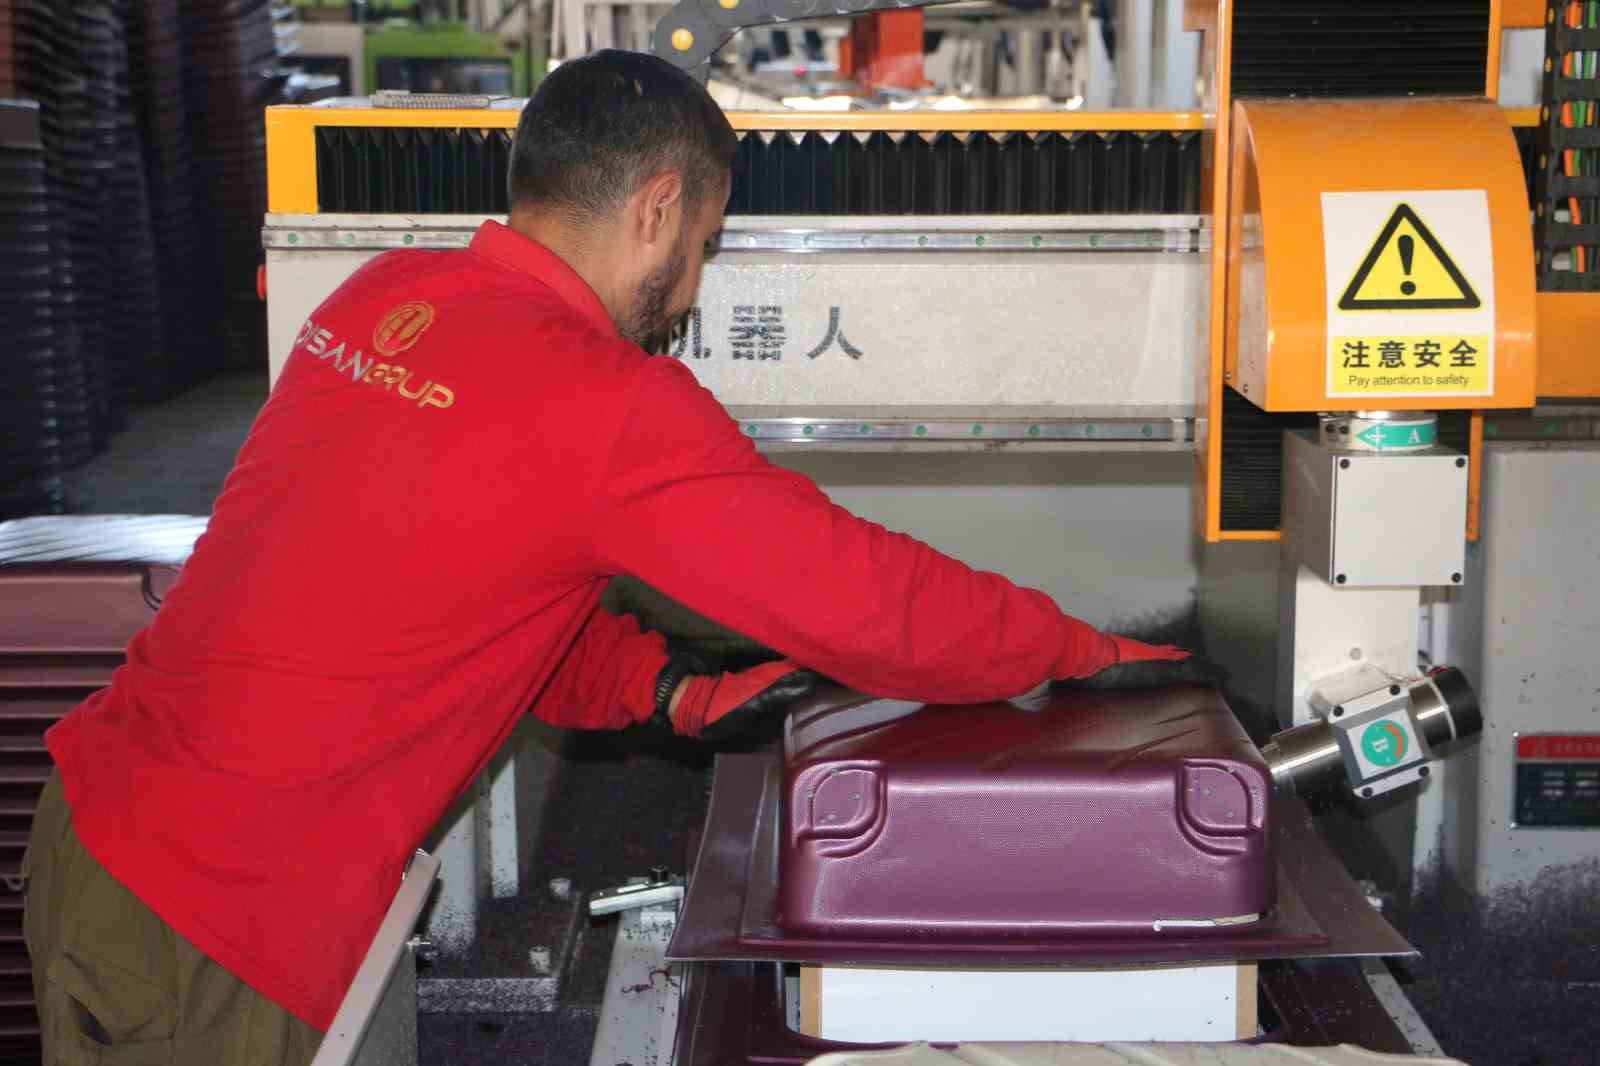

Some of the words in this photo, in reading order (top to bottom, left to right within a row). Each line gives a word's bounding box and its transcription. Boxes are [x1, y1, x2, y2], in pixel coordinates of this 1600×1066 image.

[1342, 339, 1477, 368] 注意安全
[1348, 375, 1371, 388] Pay
[1373, 374, 1419, 386] attention
[1423, 374, 1434, 385] to
[1436, 374, 1470, 387] safety
[1407, 428, 1421, 444] A
